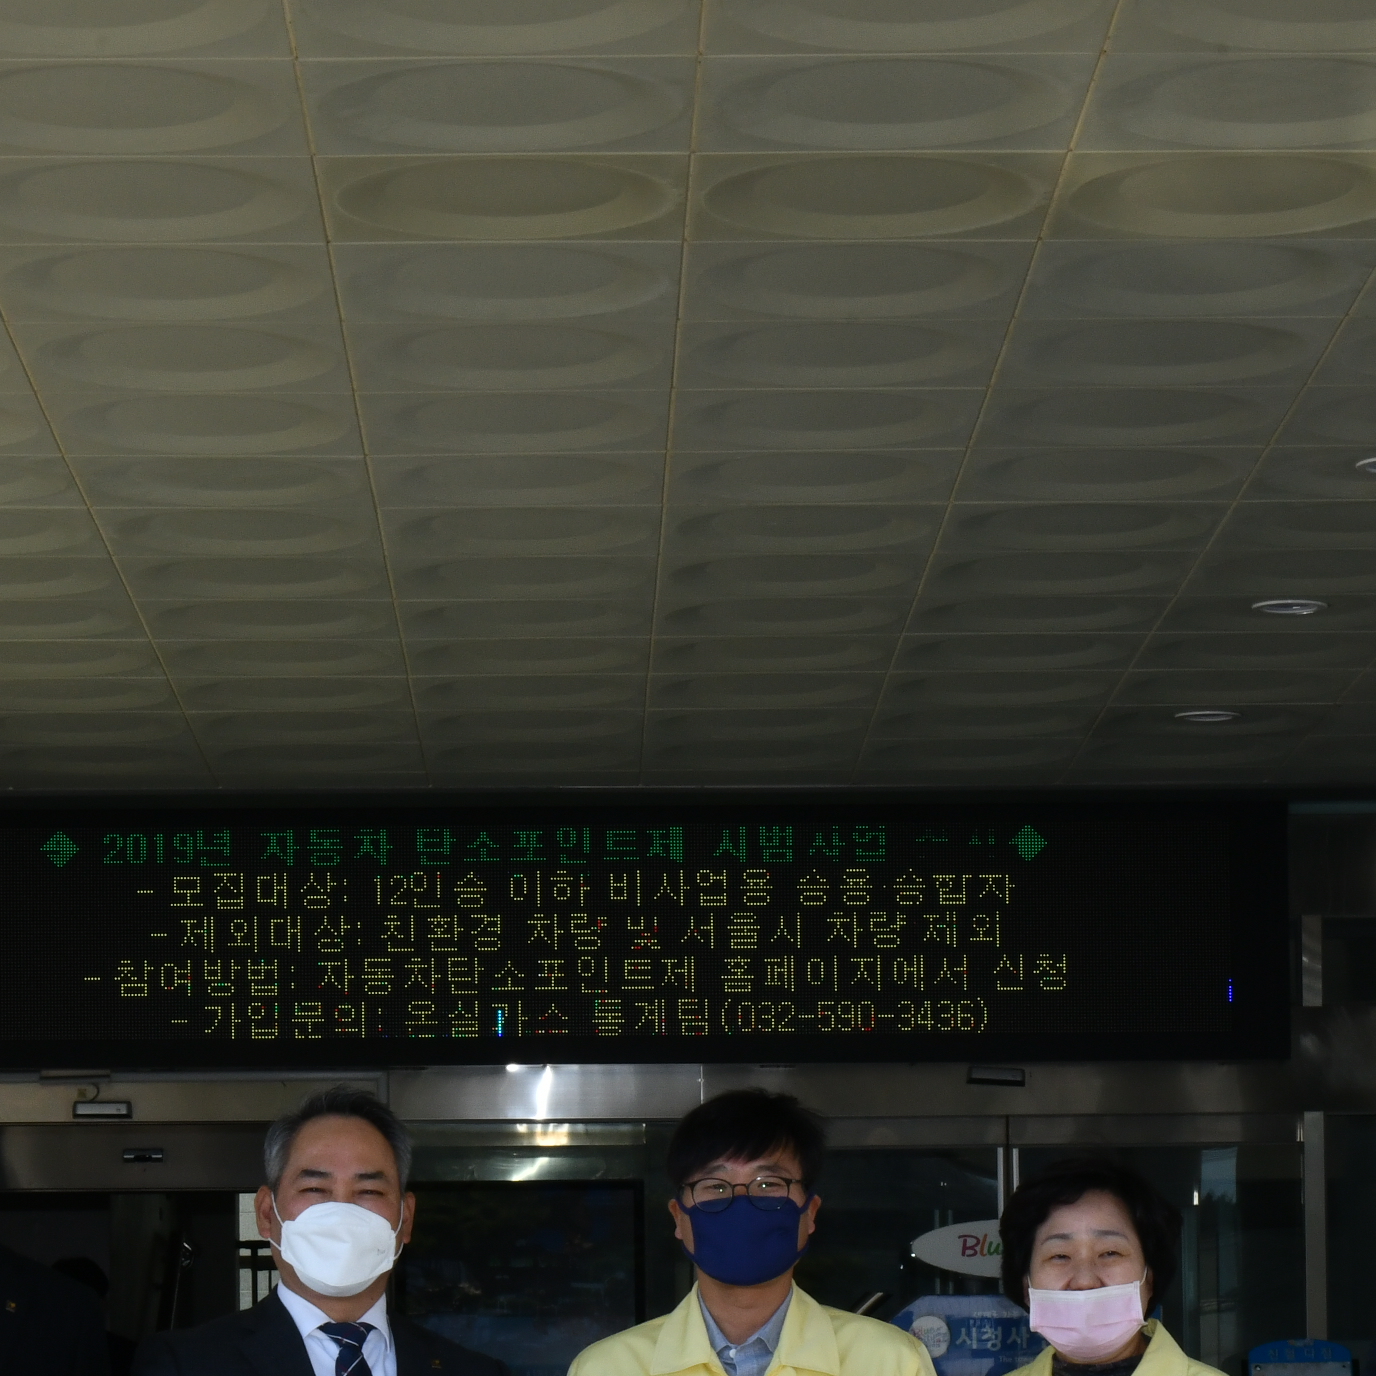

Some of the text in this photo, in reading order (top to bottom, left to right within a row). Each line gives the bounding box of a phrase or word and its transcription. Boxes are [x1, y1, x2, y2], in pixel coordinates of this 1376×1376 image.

[103, 829, 231, 867] 2019년
[416, 826, 684, 865] 탄소포인트제
[712, 825, 886, 863] 시범사업
[373, 870, 488, 909] 12인승
[510, 869, 591, 907] 이하
[609, 868, 774, 907] 비사업용
[381, 913, 502, 952] 친환경
[527, 912, 608, 951] 차량
[627, 915, 662, 951] 및
[680, 911, 801, 950] 서울시
[826, 910, 907, 949] 차량
[923, 910, 1001, 948] 제외
[317, 955, 695, 997] 자동차탄소포인트제
[721, 953, 969, 993] 홈페이지에서
[993, 952, 1067, 992] 신청
[405, 999, 569, 1039] 온실가스
